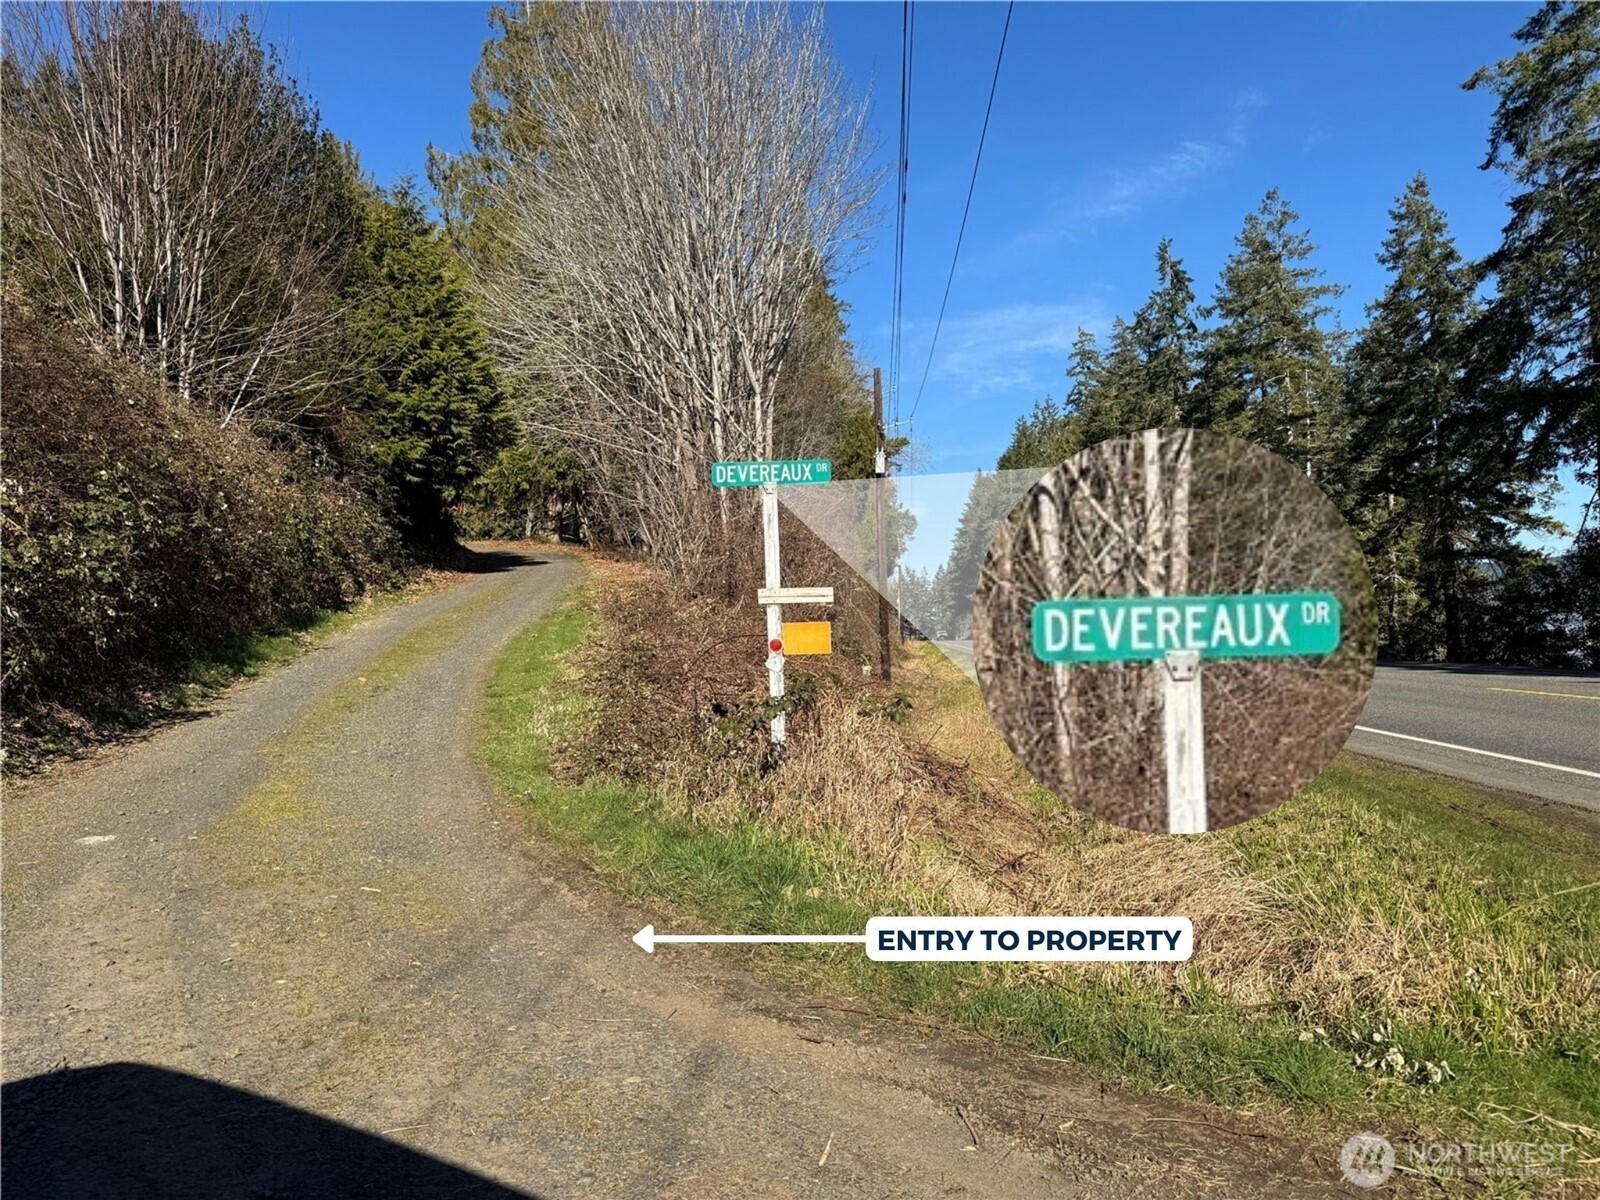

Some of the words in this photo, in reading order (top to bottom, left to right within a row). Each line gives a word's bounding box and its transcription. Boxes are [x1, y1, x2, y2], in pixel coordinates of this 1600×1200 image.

[716, 463, 813, 483] DEVEREAUX
[816, 463, 828, 472] DR
[1043, 603, 1291, 652] DEVEREAUX
[1302, 602, 1330, 624] DR
